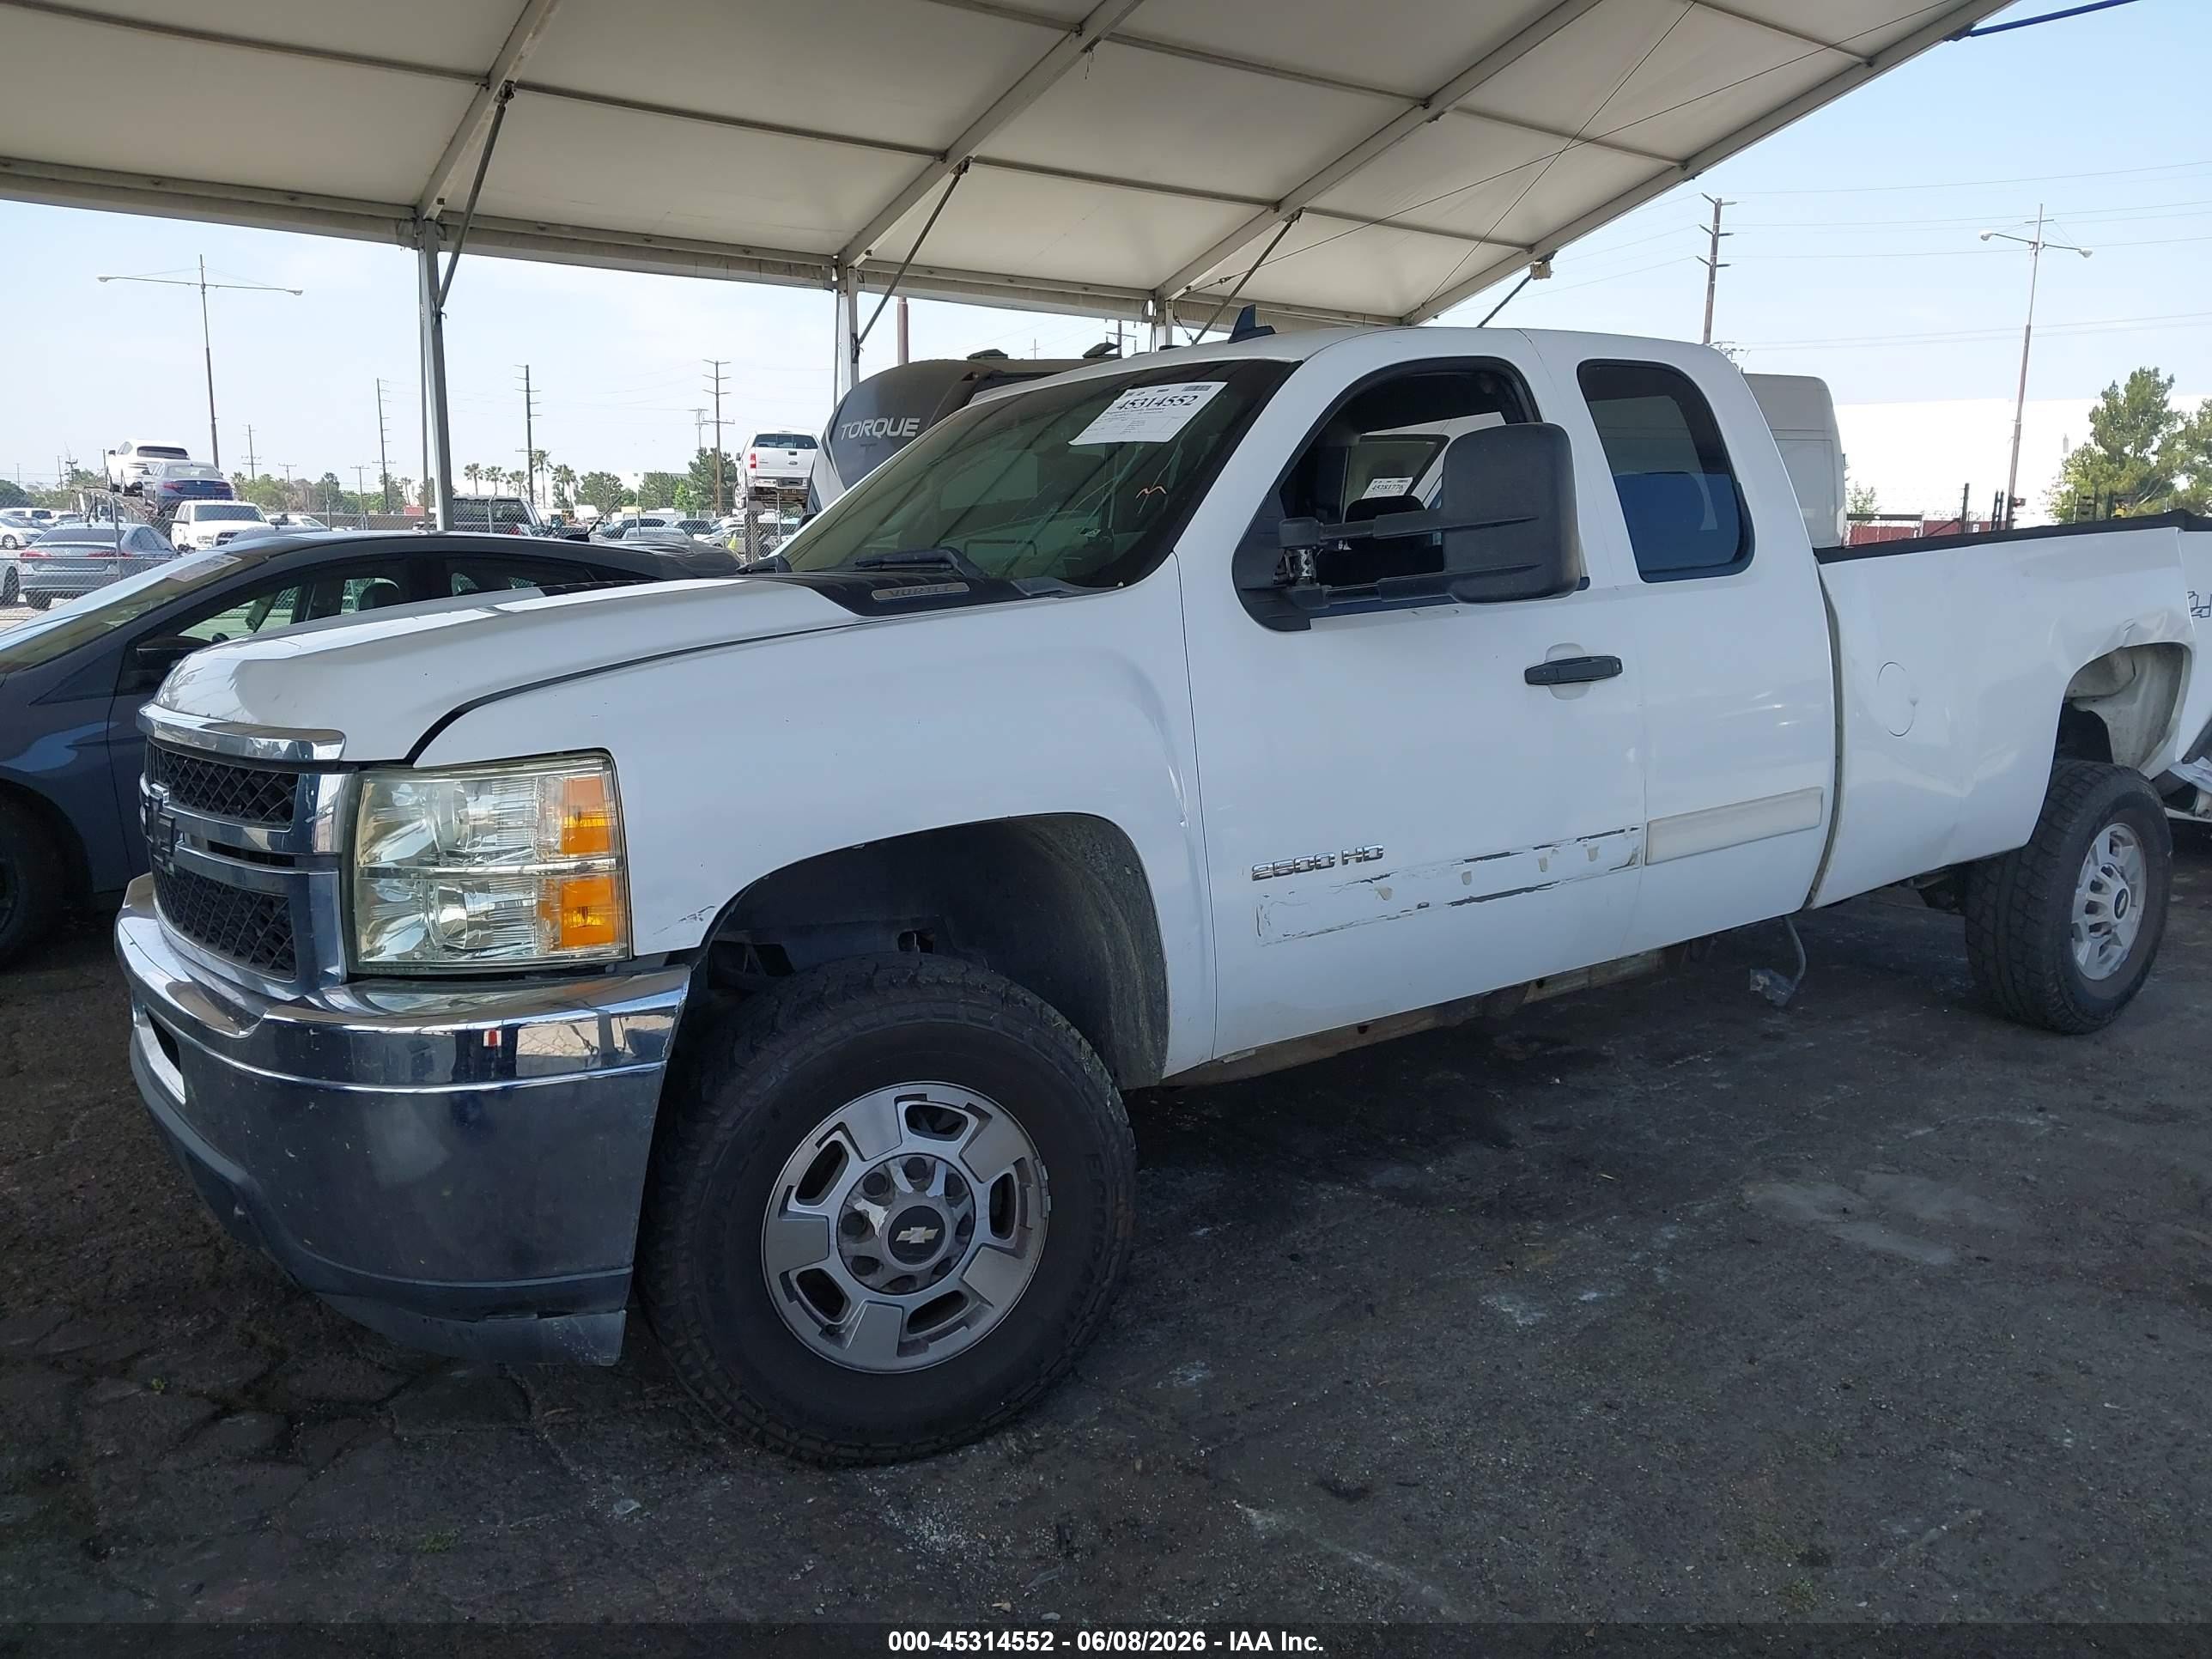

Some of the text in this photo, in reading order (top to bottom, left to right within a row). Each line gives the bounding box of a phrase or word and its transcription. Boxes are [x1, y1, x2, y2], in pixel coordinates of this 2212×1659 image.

[1117, 394, 1199, 410] 45314552
[842, 417, 921, 441] TORQUE
[1252, 844, 1383, 881] 2500 HD
